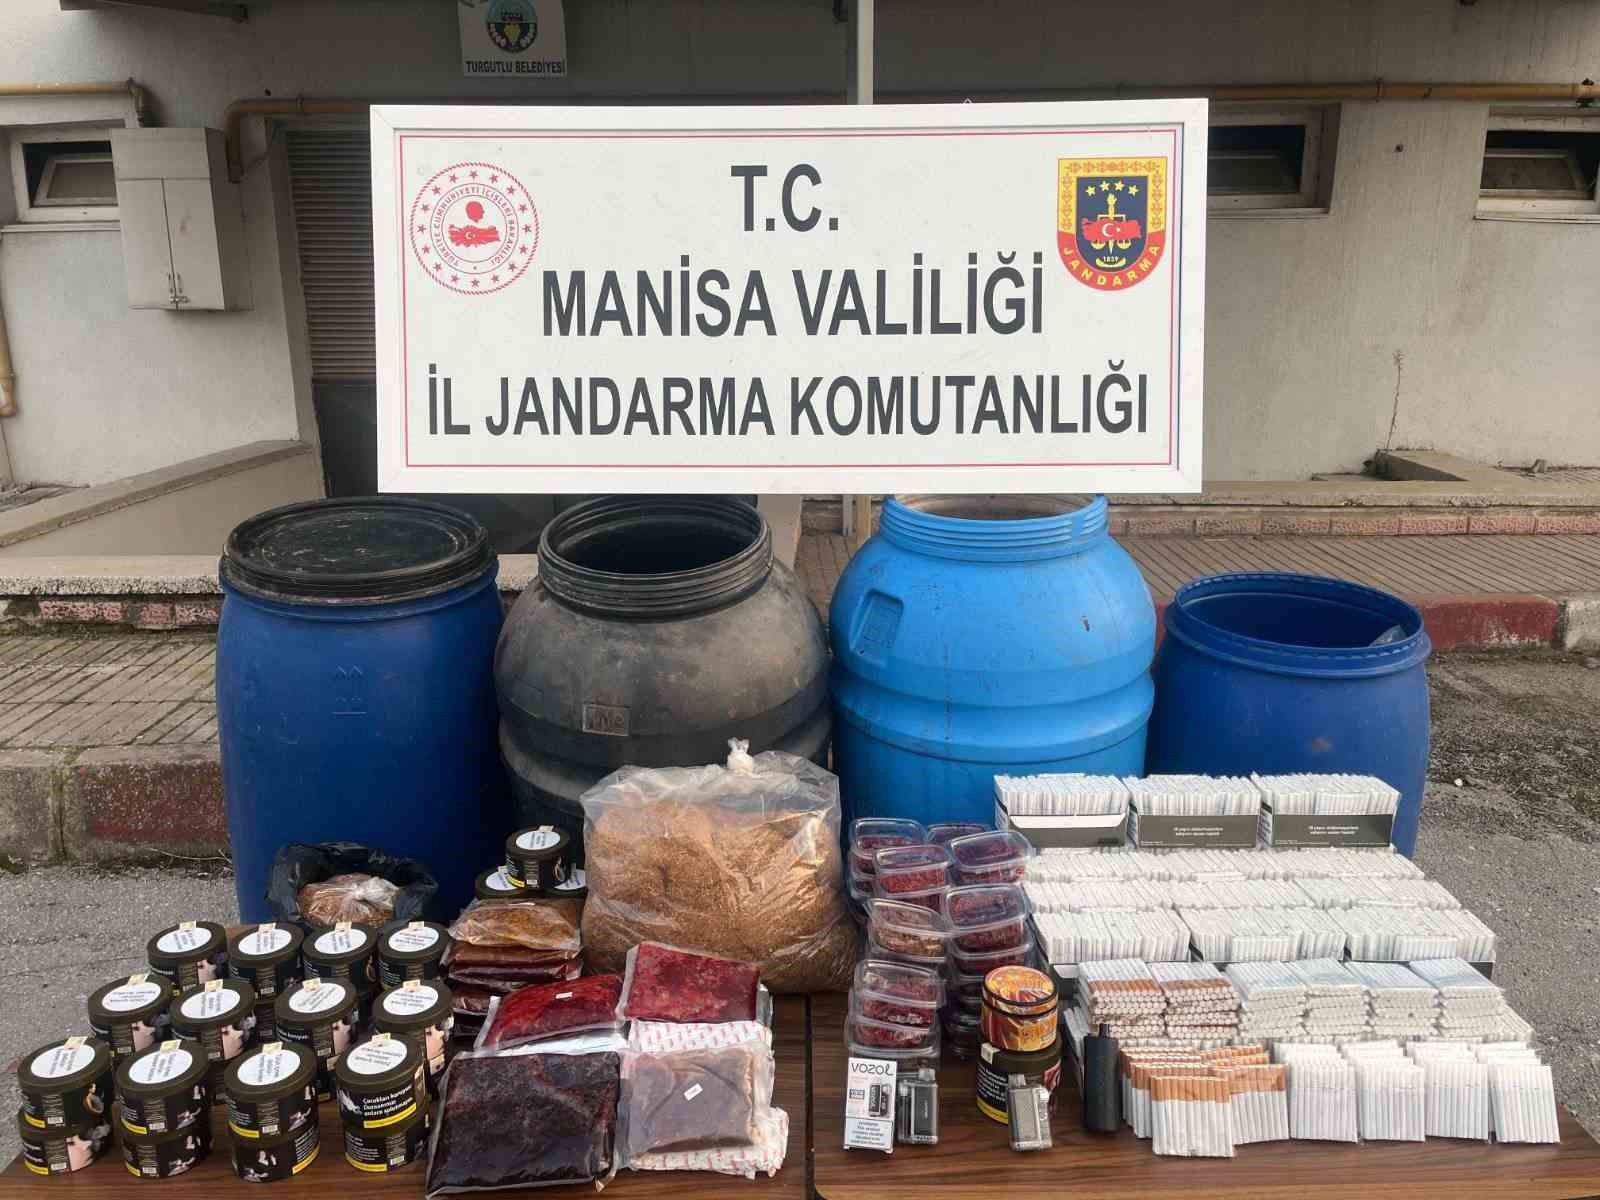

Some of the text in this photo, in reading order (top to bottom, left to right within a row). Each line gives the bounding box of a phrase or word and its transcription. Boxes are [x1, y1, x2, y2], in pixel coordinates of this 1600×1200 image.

[465, 61, 512, 73] TURGUTLU
[731, 164, 838, 232] T.C.
[543, 252, 1043, 337] MANİSA VALİLİĞİ
[1063, 245, 1160, 286] JANDARMA
[428, 360, 1147, 436] İL JANDARMA KOMUTANLIĞI
